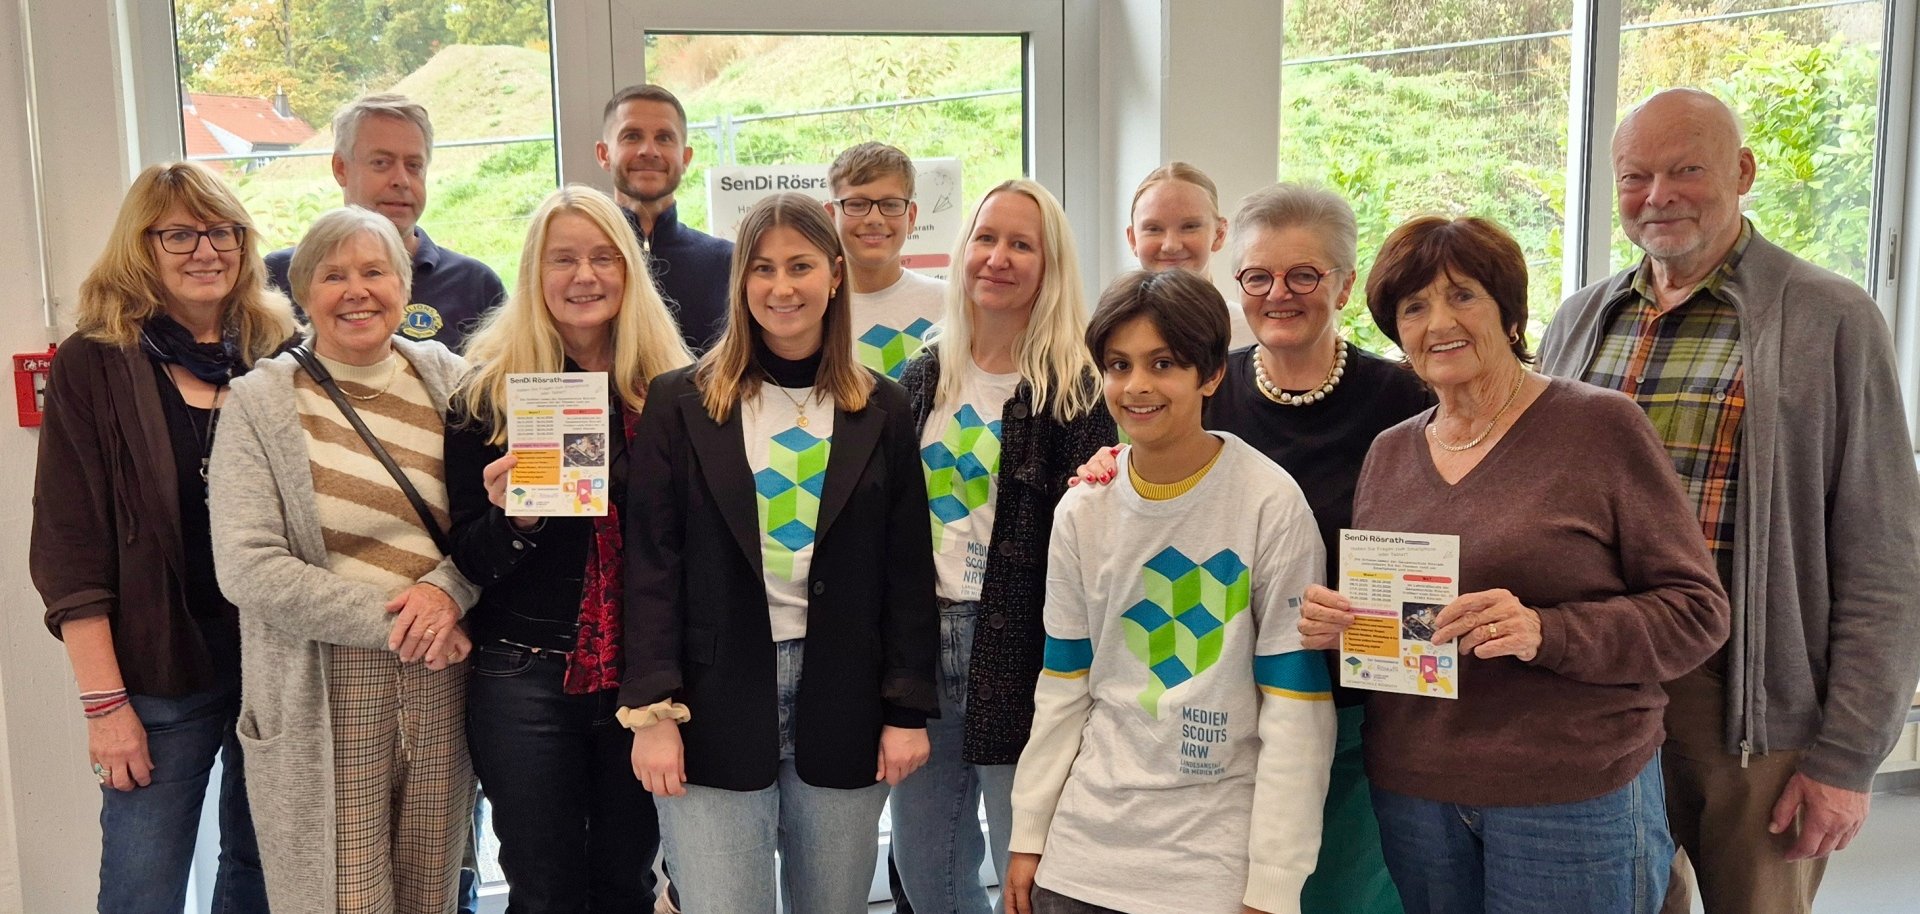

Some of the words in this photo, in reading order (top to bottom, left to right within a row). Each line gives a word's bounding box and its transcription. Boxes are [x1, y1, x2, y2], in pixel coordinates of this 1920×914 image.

[721, 175, 773, 191] SenDi
[777, 174, 827, 190] Rösra
[414, 313, 428, 328] L
[1344, 533, 1368, 541] SenDi
[1369, 535, 1405, 544] Rösrath
[967, 541, 988, 558] MEDI
[1182, 706, 1228, 726] MEDIEN
[1182, 723, 1227, 743] SCOUTS
[1181, 740, 1209, 759] NRW
